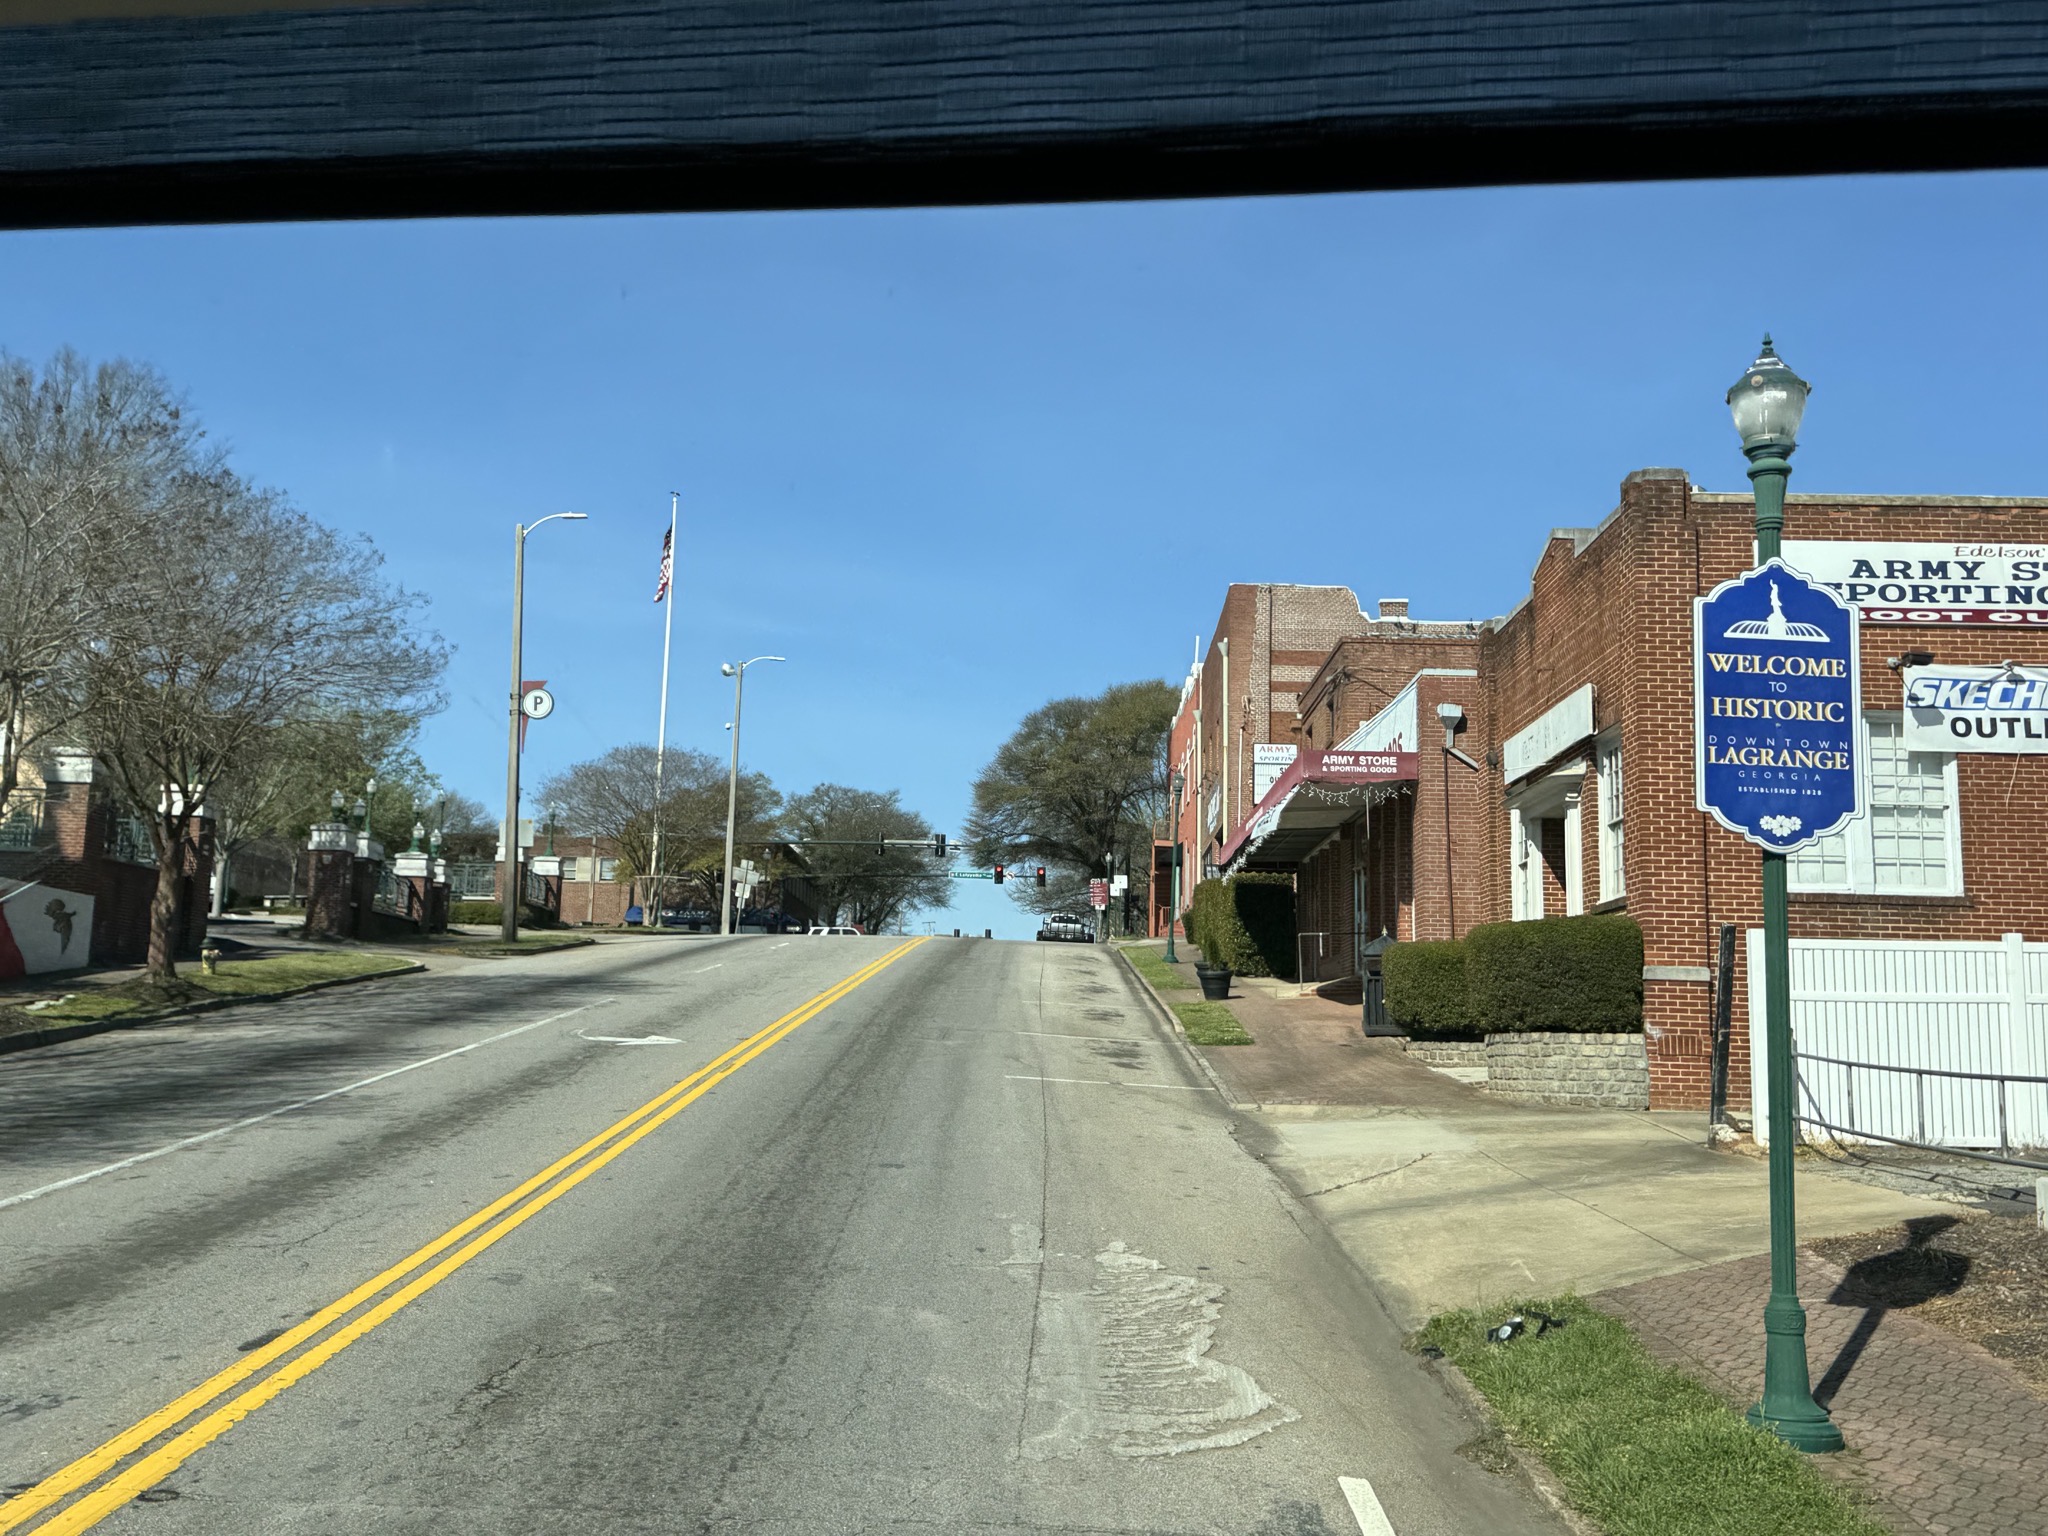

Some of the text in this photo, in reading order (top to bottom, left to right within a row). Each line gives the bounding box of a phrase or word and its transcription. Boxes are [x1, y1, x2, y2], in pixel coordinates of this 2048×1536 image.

[1849, 559, 2048, 581] ARMY S
[1860, 610, 1973, 622] OOT
[1707, 653, 1847, 678] WELCOME
[1769, 682, 1787, 693] TO
[1907, 678, 2048, 710] SKECH
[534, 696, 544, 711] P
[1711, 697, 1845, 722] HISTORIC
[1950, 717, 2048, 739] OUTL
[1259, 745, 1291, 753] ARMY
[1709, 735, 1848, 750] DOWNTOWN
[1322, 755, 1397, 766] ARMY STORE
[1708, 746, 1850, 770] LAGRANGE
[1330, 765, 1367, 773] SPORTING
[1738, 770, 1821, 781] GEORGIA
[1738, 786, 1797, 795] ESTABLISHED
